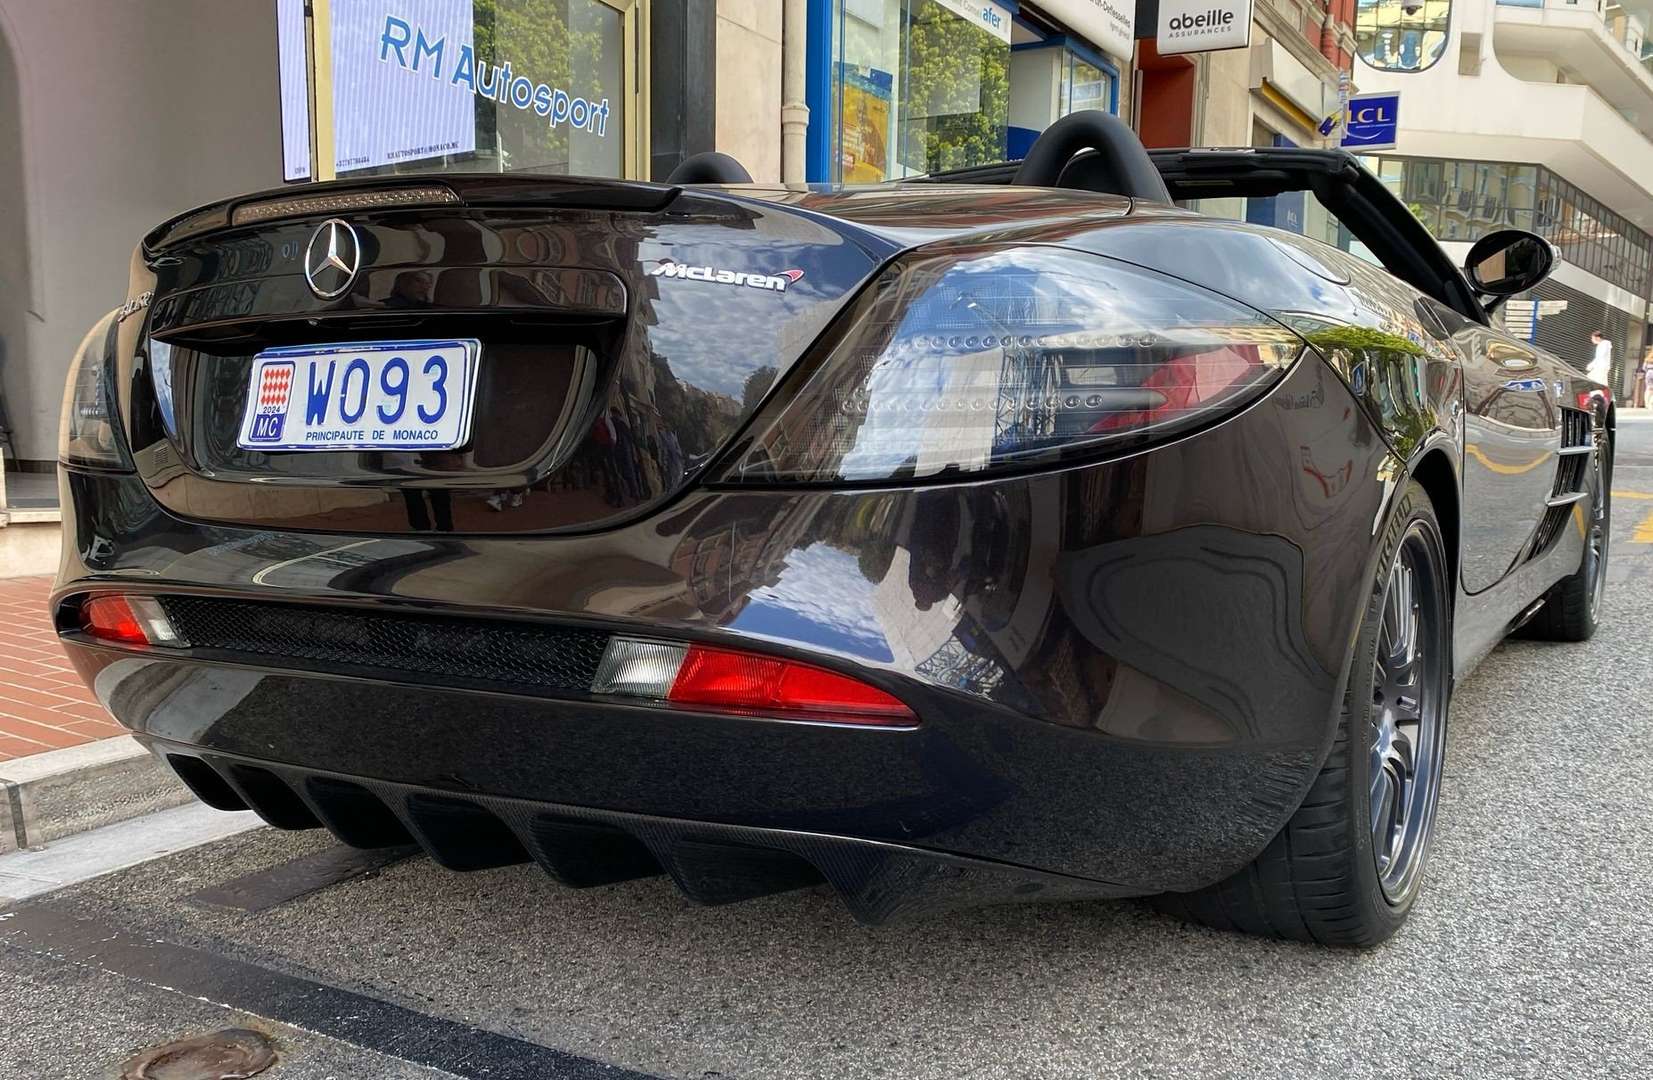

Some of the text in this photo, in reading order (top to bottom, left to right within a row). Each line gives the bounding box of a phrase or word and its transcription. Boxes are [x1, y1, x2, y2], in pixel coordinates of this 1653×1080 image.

[982, 5, 1002, 30] afer
[1168, 8, 1234, 30] abeille
[1168, 25, 1232, 39] ASSURANCES
[380, 15, 610, 136] RM Autosport
[1345, 107, 1391, 125] LCL
[651, 262, 787, 292] McLaren
[306, 355, 448, 426] W093
[263, 405, 281, 414] 2024
[256, 417, 278, 438] MC
[306, 430, 438, 441] PRINCIPAUTE DE MONACO
